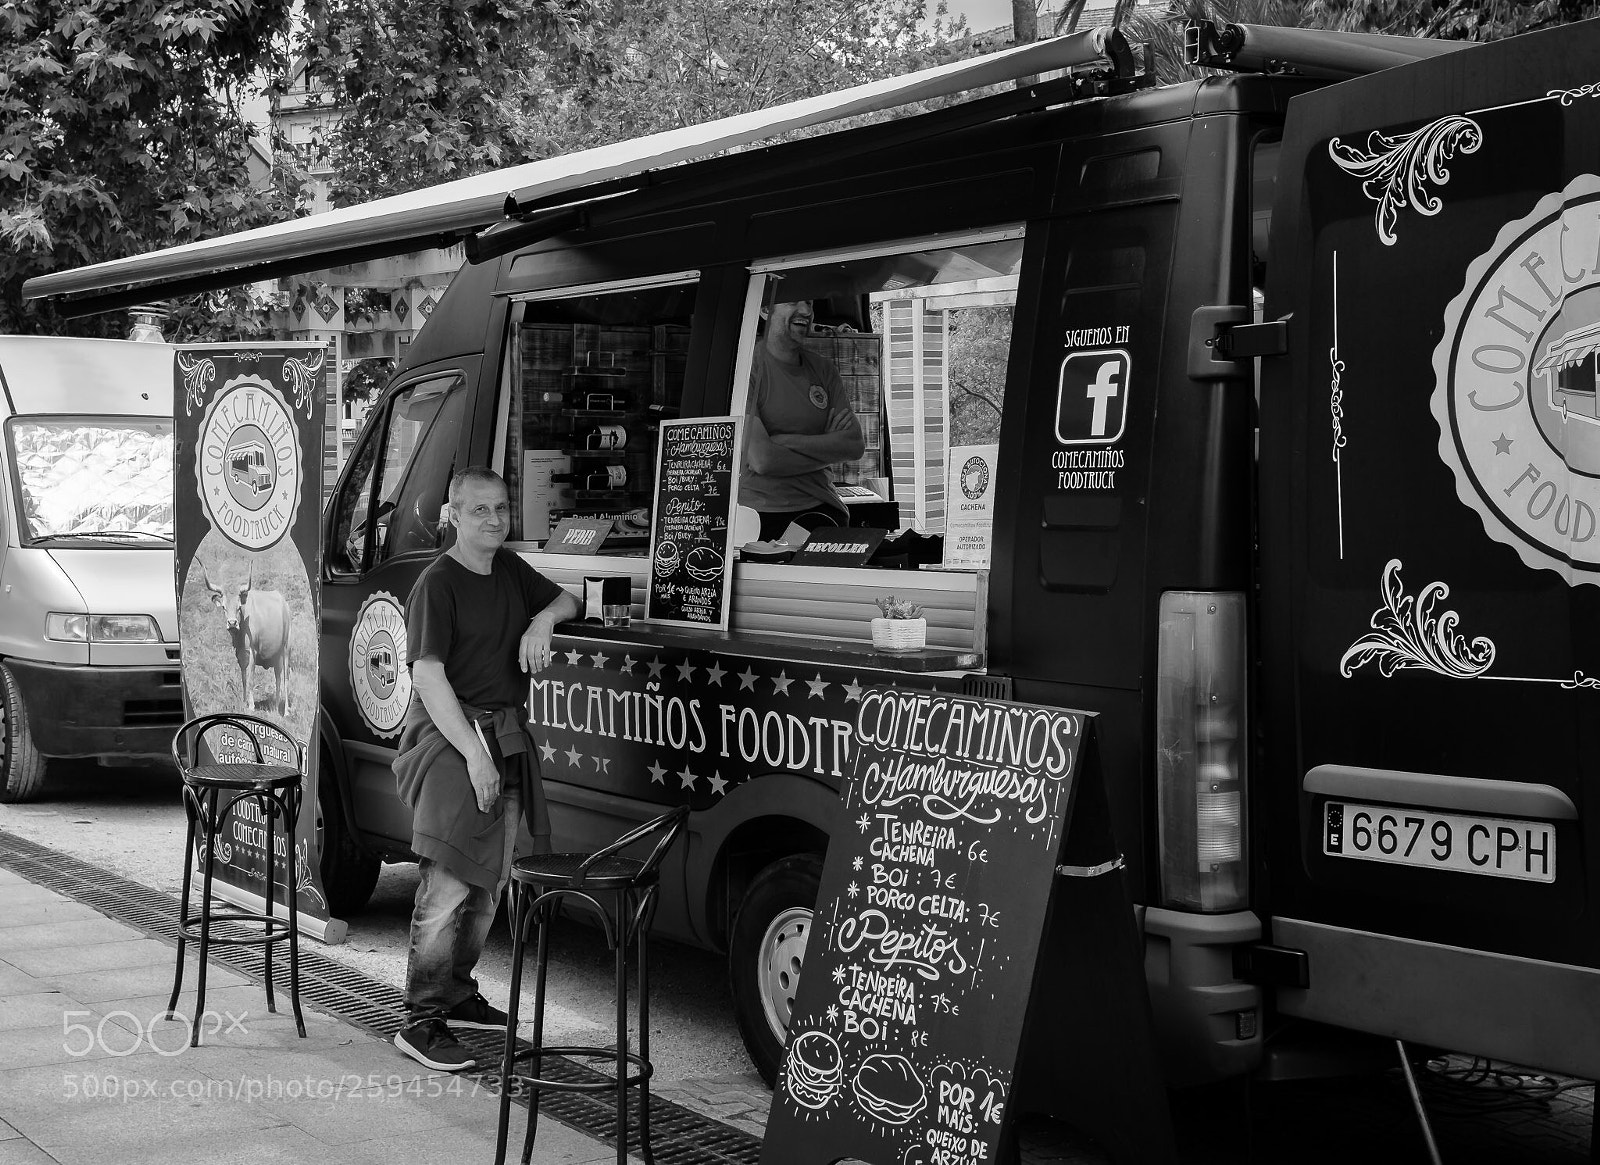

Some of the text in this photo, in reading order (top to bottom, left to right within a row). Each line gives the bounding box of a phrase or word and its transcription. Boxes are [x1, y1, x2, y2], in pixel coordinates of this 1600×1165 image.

[1064, 325, 1130, 348] SIGUENOS EN
[206, 393, 293, 477] COMECAMIÑOS
[1052, 446, 1125, 469] COMECAMIÑOS
[1058, 471, 1115, 489] FOODTRUCK
[960, 503, 986, 511] CACHENA
[1504, 462, 1600, 543] FOOD
[217, 501, 286, 540] FOODTRUCK
[804, 542, 870, 554] RECOLLER
[362, 690, 403, 723] FOODTRUCK
[524, 677, 706, 753] MECAMIÑOS
[221, 732, 235, 747] de
[263, 744, 292, 763] natural
[858, 694, 1071, 774] COMECAMIÑOS
[863, 756, 1047, 823] Hamburguesas
[870, 837, 935, 868] CACHENA
[968, 840, 988, 863] 6€
[1330, 833, 1338, 845] E
[1352, 812, 1548, 875] 6679 CPH
[931, 870, 957, 889] 7€
[867, 885, 915, 911] PORCO
[979, 903, 999, 928] 7€
[838, 909, 967, 980] Pepitos
[839, 986, 916, 1025] CACHENA
[911, 1030, 929, 1048] 8€
[940, 1080, 1004, 1124] POR 1€
[970, 1139, 988, 1159] DE
